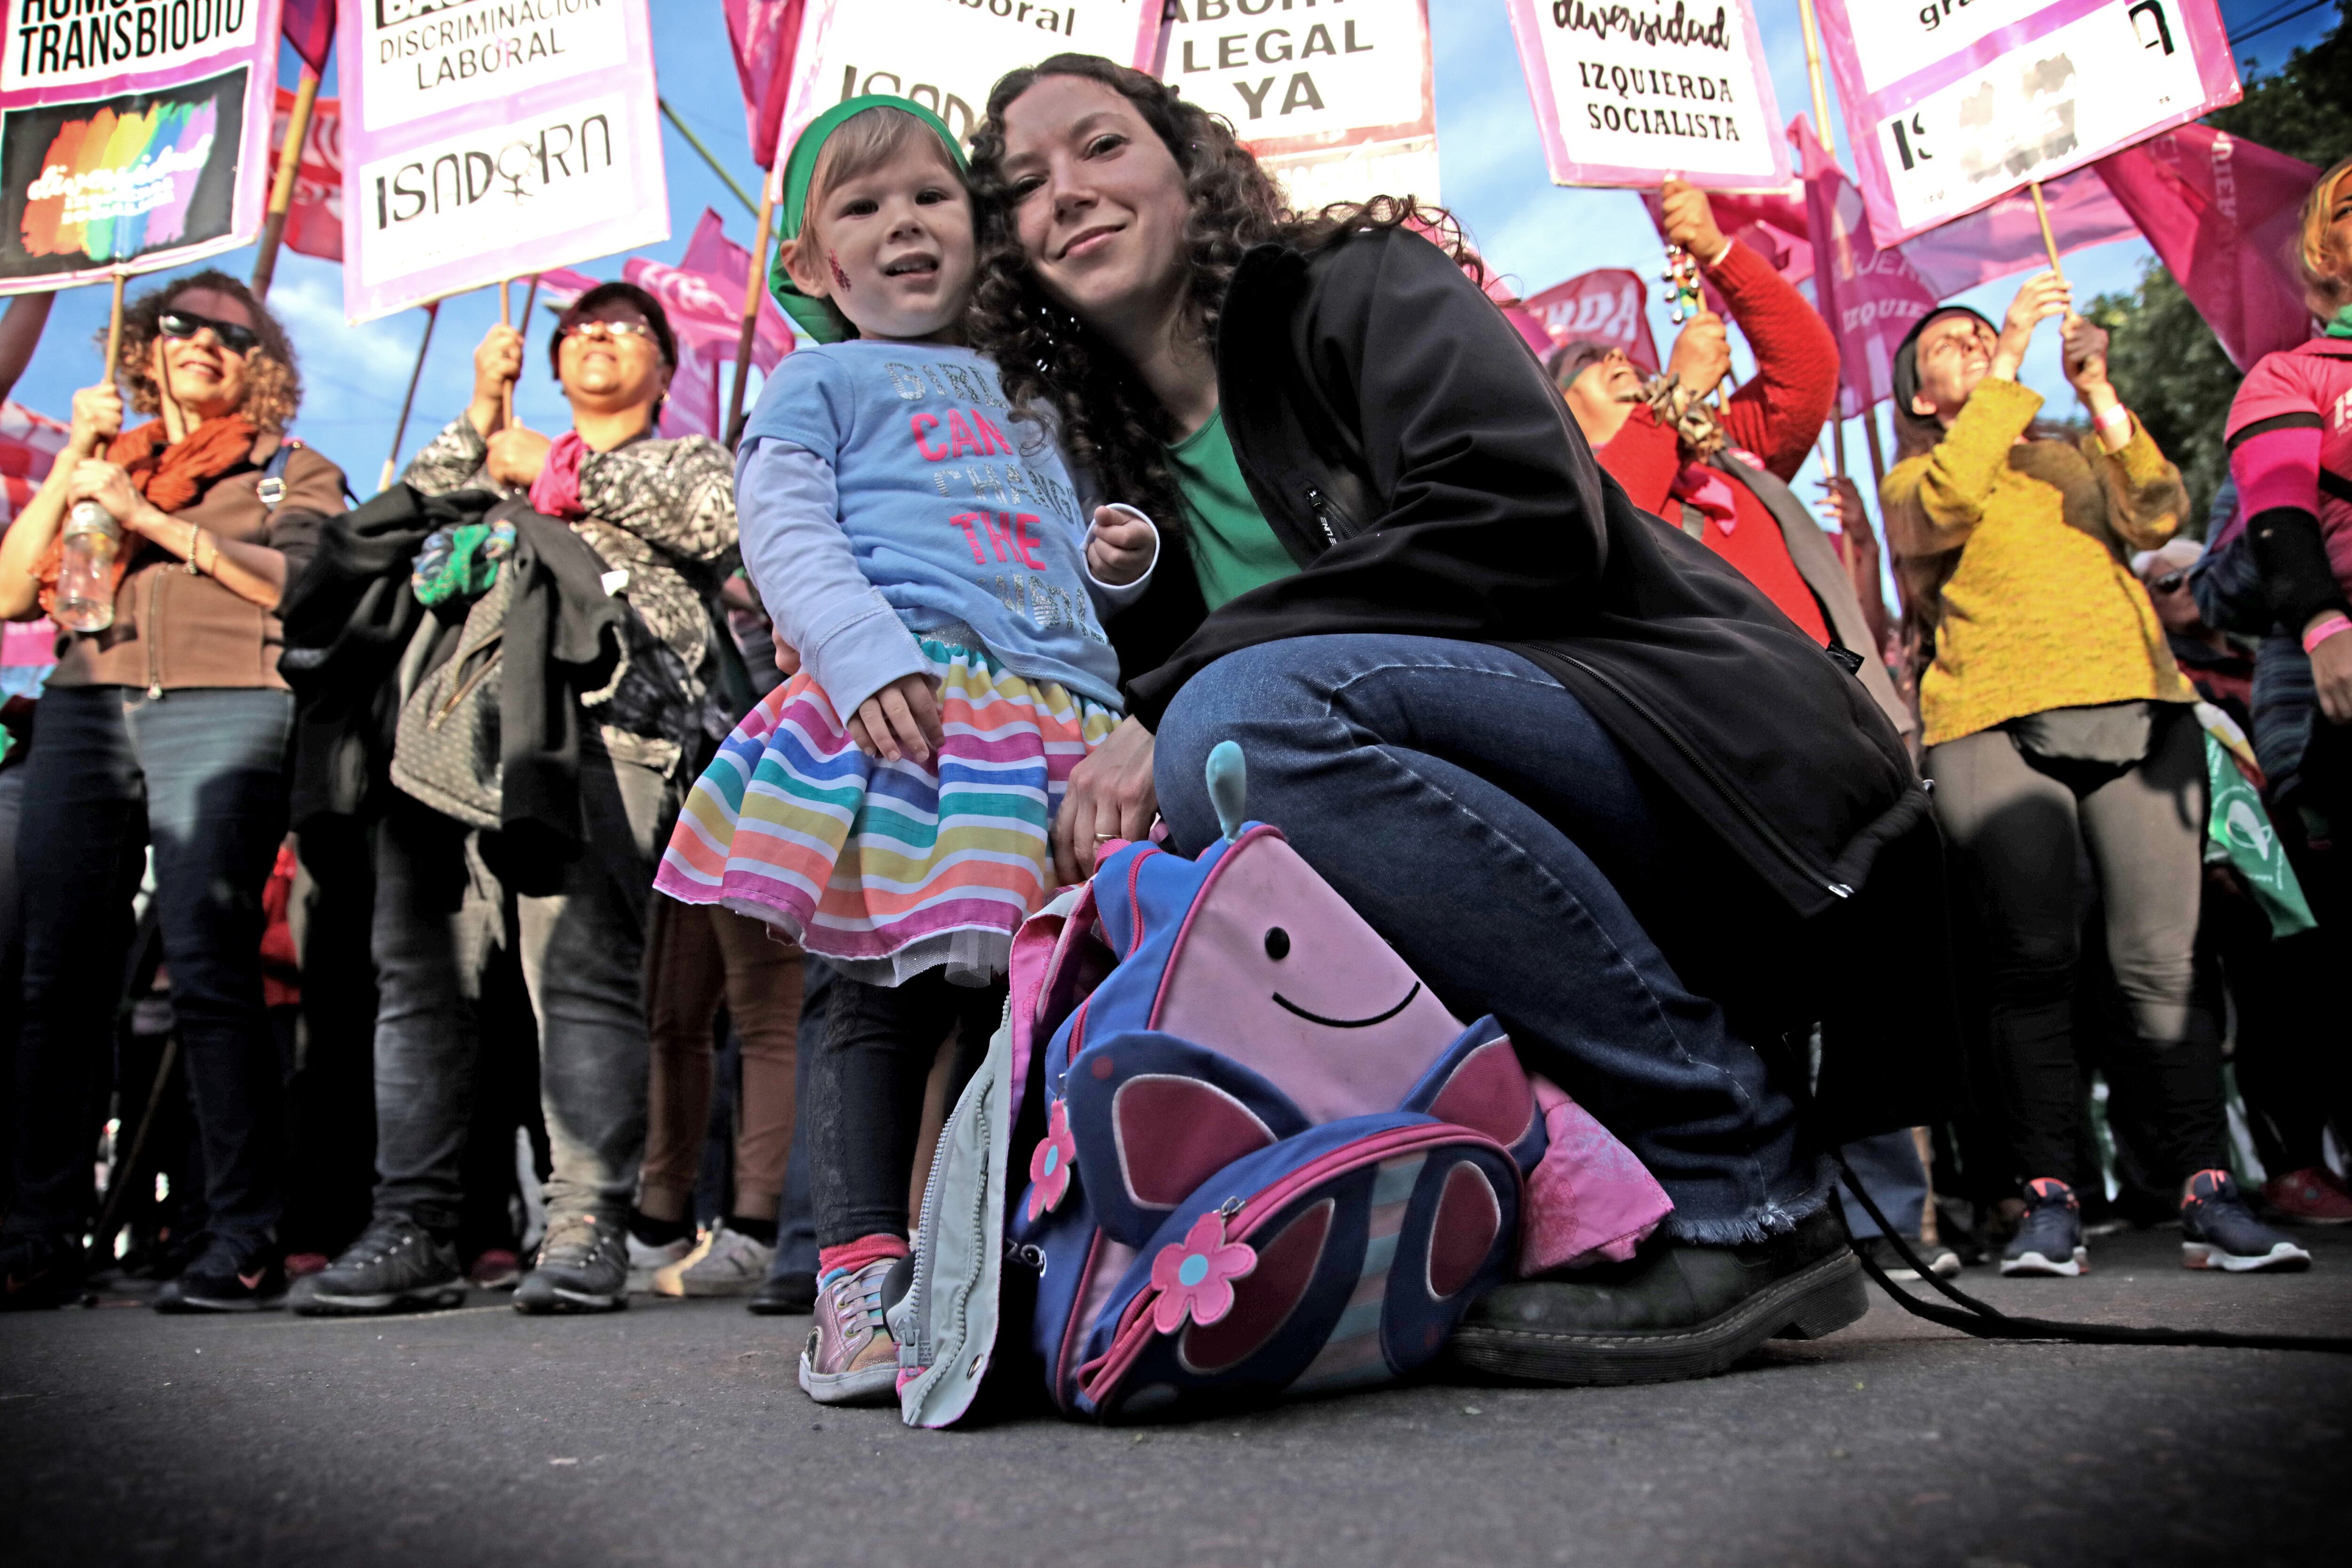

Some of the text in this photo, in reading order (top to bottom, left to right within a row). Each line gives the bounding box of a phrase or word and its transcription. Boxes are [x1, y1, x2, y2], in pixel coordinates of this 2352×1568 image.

[1183, 20, 1374, 73] LEGAL
[1553, 0, 1729, 51] diversidad
[417, 28, 566, 90] LABORAL
[1578, 61, 1734, 102] IZQUIERDA
[1232, 72, 1326, 120] YA
[1588, 103, 1740, 141] SOCIALISTA
[884, 362, 1010, 409] GIRL
[911, 408, 1013, 462] CAN
[949, 511, 1046, 571] THE
